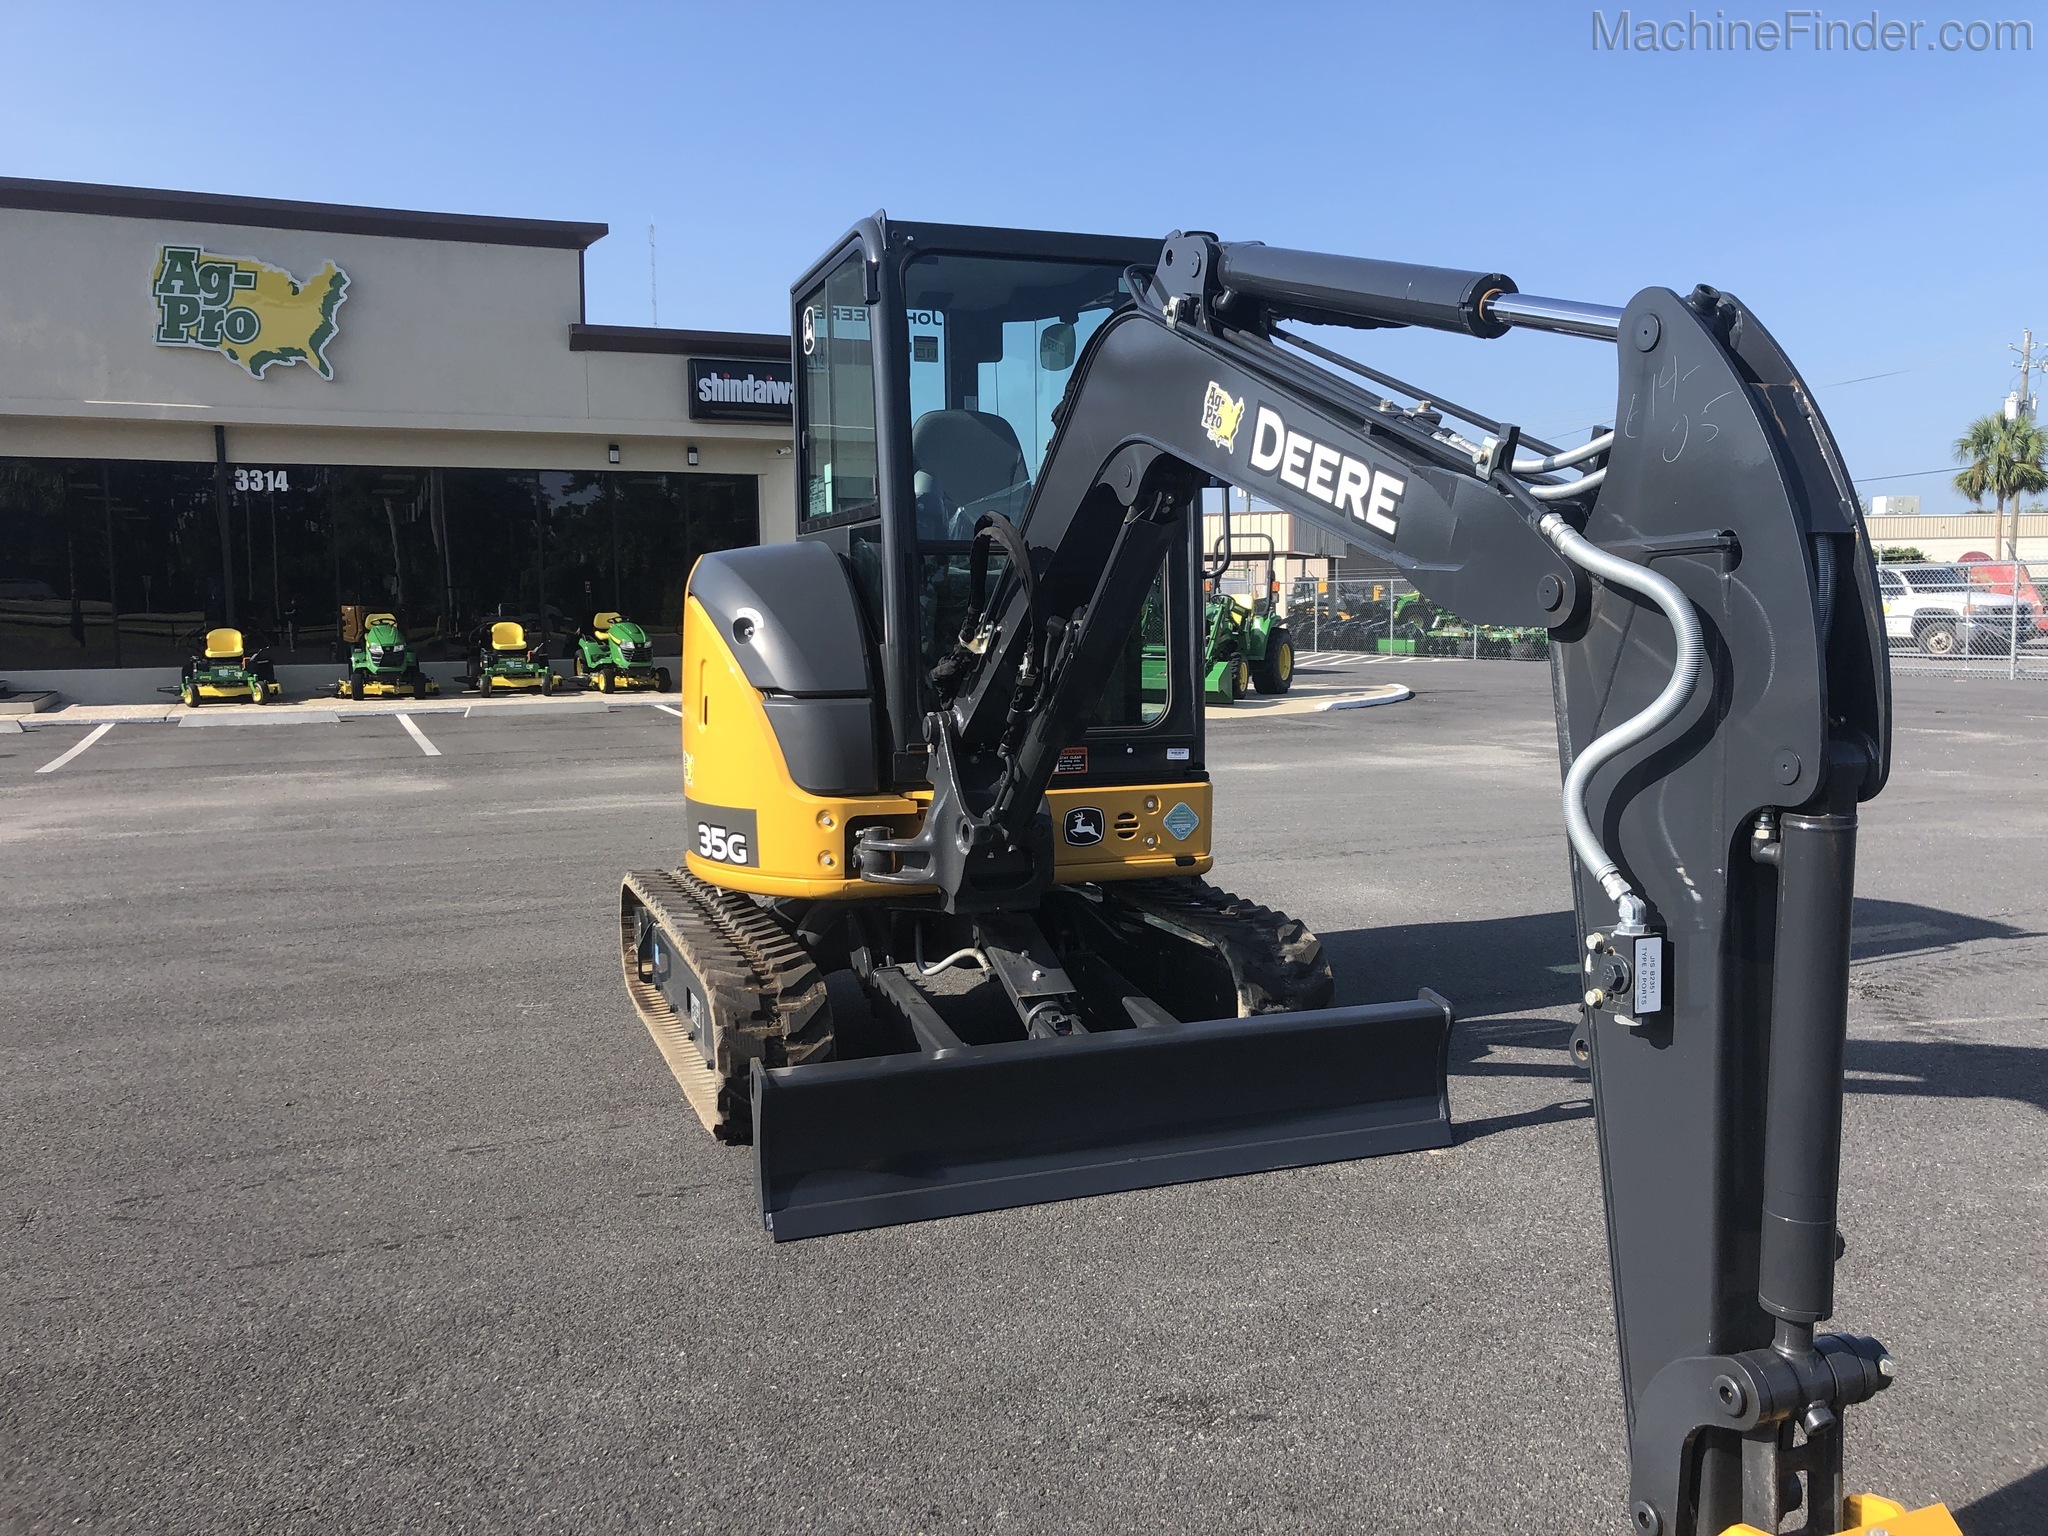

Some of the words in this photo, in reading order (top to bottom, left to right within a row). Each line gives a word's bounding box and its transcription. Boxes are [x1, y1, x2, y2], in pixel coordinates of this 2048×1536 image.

[155, 247, 256, 308] Ag-
[157, 294, 260, 344] Pro
[1204, 405, 1223, 429] Pro
[1207, 386, 1226, 412] Ag-
[235, 469, 289, 492] 3314
[1250, 406, 1405, 536] DEERE
[698, 822, 748, 864] 35G
